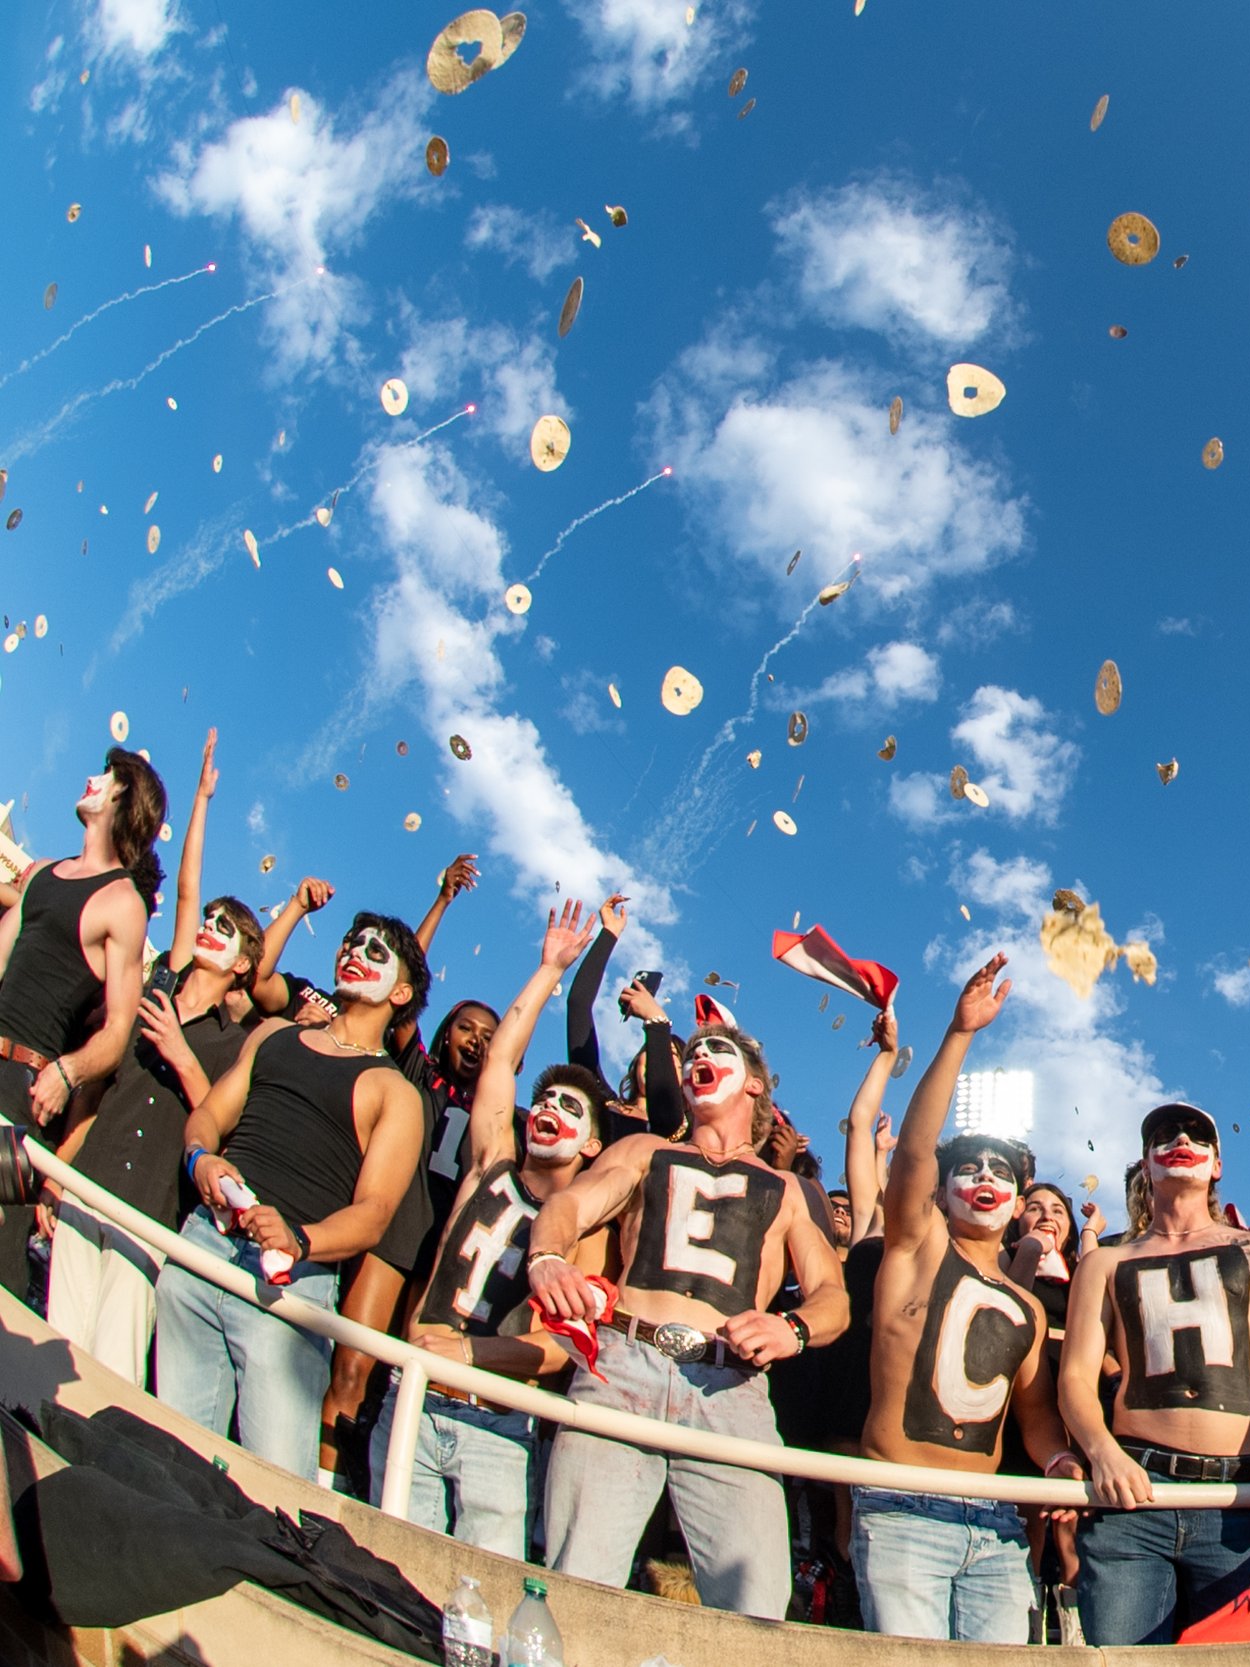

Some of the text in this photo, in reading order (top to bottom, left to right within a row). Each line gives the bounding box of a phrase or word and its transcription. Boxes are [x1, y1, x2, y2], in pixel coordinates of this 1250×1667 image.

[429, 1107, 470, 1181] 1
[662, 1164, 749, 1286] E
[932, 1274, 1028, 1425] C
[1137, 1254, 1234, 1379] H
